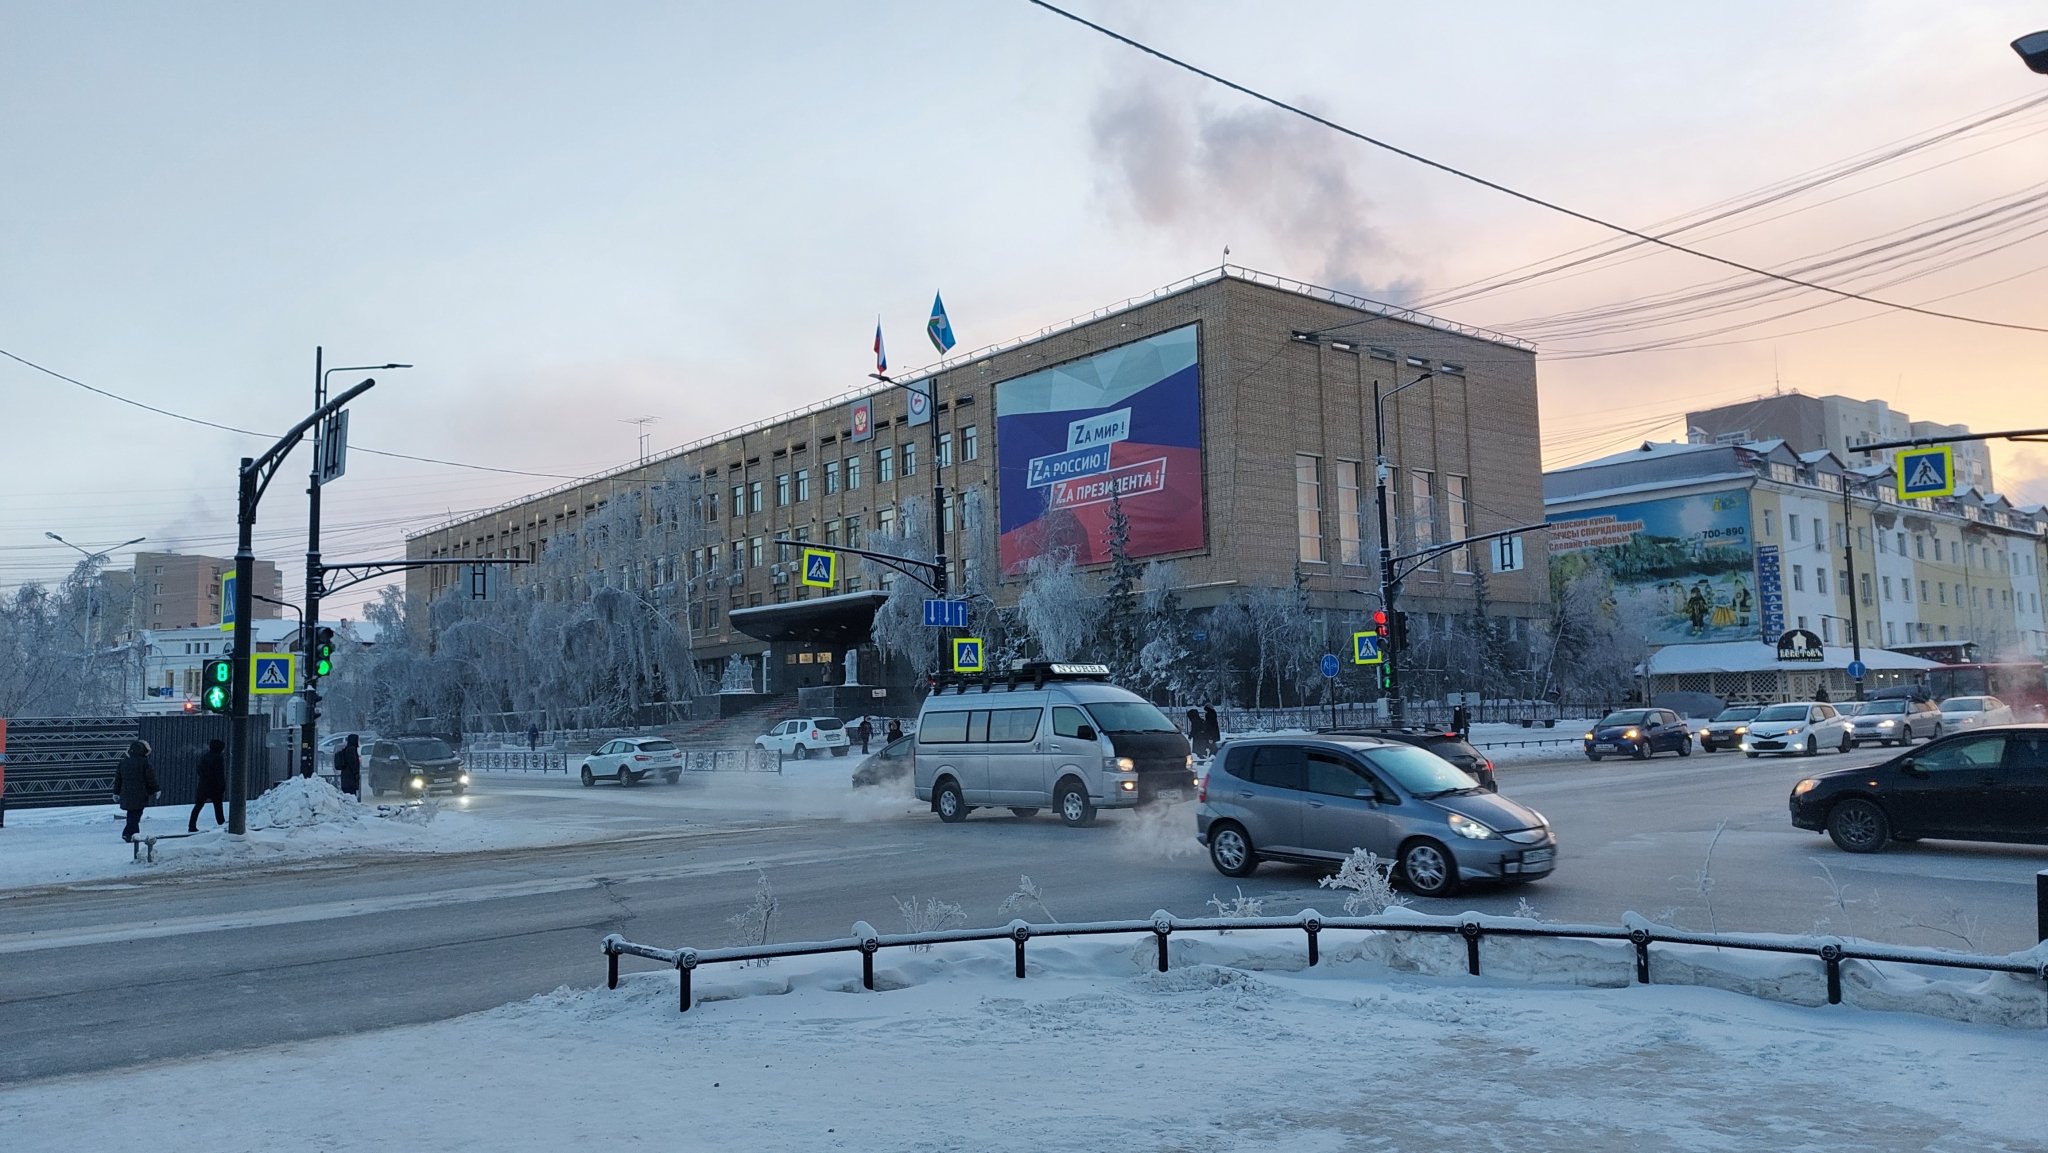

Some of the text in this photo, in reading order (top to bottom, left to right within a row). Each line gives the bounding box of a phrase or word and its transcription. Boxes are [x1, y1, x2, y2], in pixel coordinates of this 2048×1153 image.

[1702, 526, 1745, 539] 700-890
[217, 662, 228, 682] 8
[1056, 665, 1107, 673] NYURBA
